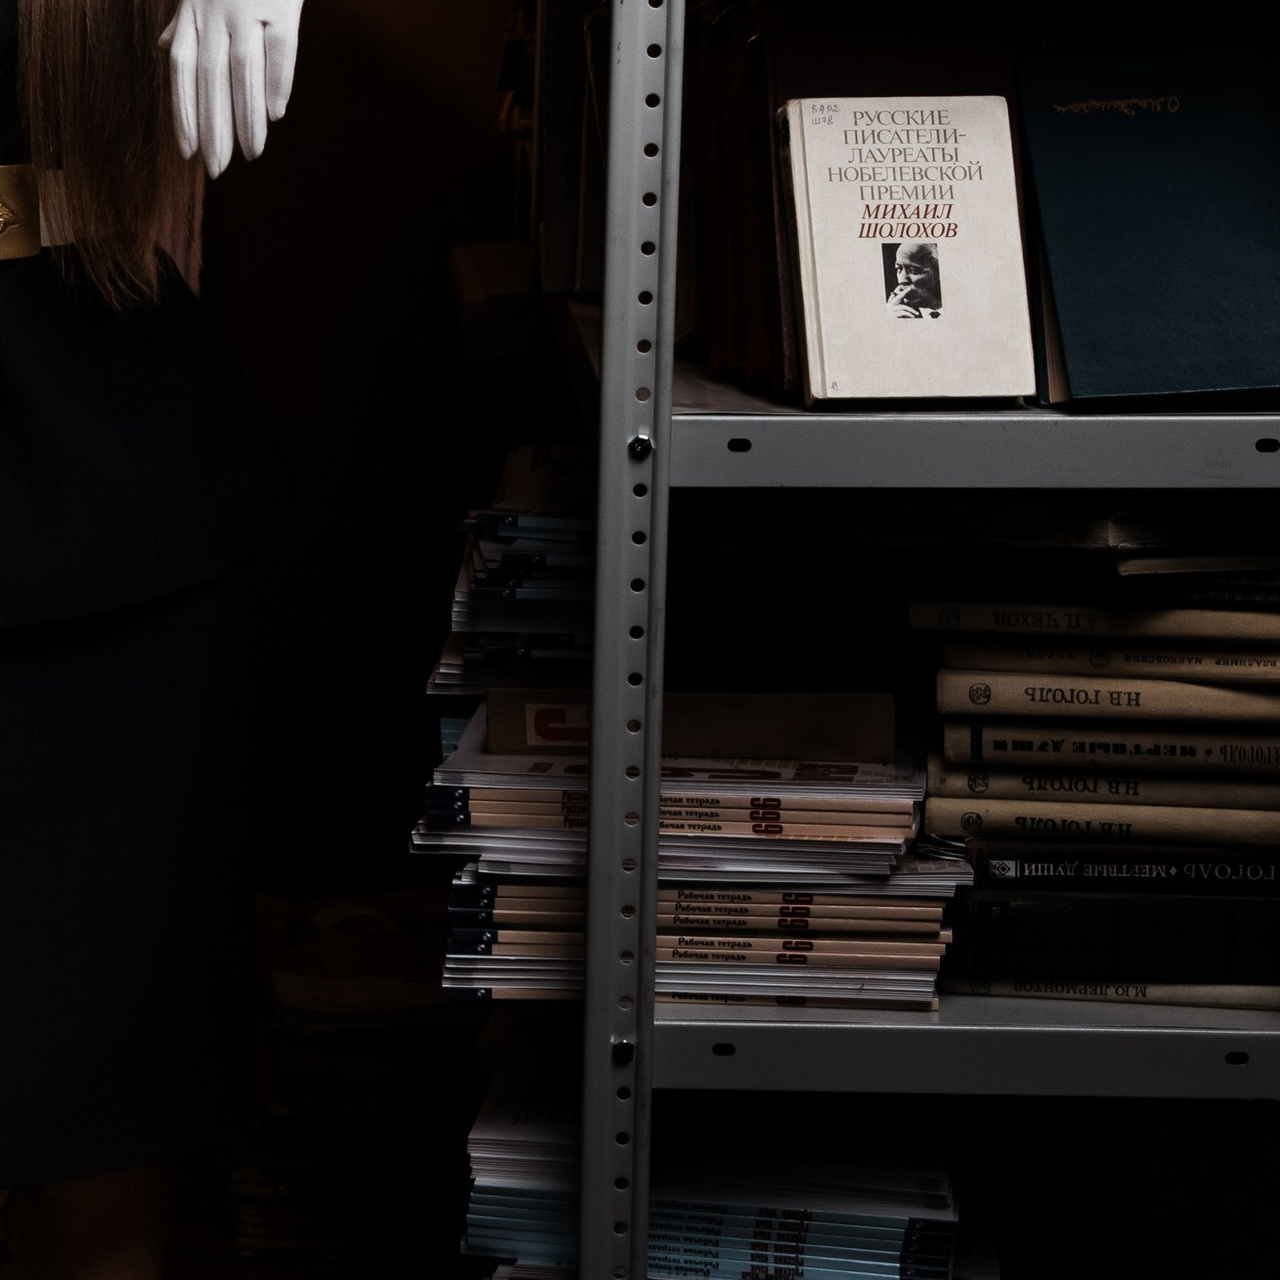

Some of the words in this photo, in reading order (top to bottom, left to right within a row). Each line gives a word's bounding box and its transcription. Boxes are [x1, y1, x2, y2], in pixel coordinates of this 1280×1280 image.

[853, 109, 950, 127] РУССКИЕ
[843, 128, 967, 145] ПИСАТЕЛИ-
[847, 147, 960, 163] ЛАУРЕАТЫ
[827, 160, 984, 182] НОБЕЛЕВСКОЙ
[859, 185, 955, 201] ПРЕМИИ
[862, 203, 954, 220] МИХАИЛ
[857, 222, 958, 239] ШОЛОХОВ
[992, 611, 1060, 629] ЧЕХОВ
[1124, 654, 1203, 665] МАЯКОВСКИЙ
[1214, 657, 1277, 668] ВЛАДИМИР
[1024, 687, 1100, 706] ГОГОЛЬ
[993, 739, 1065, 753] ДУШИ
[1072, 742, 1197, 757] МЕРТВЫЕ
[1022, 775, 1098, 795] ГОГОЛЬ
[686, 797, 720, 807] тетрадь
[685, 810, 720, 820] тетрадь
[687, 822, 722, 833] тетрадь
[1014, 816, 1092, 834] ГОГОЛЬ
[1023, 861, 1079, 877] ДУШИ
[1082, 863, 1167, 878] МЕРТВЫЕ
[1183, 863, 1276, 881] ГОГОЛЬ
[678, 890, 715, 900] Рабочая
[716, 893, 753, 901] тетрадь
[675, 903, 712, 913] Рабочая
[713, 905, 749, 914] тетрадь
[673, 915, 710, 926] Рабочая
[711, 917, 748, 927] тетрадь
[678, 937, 715, 948] Рабочая
[716, 939, 753, 949] тетрадь
[672, 949, 709, 959] Рабочая
[710, 952, 747, 961] тетрадь
[1013, 980, 1110, 996] ЛЕРМОНТОВ
